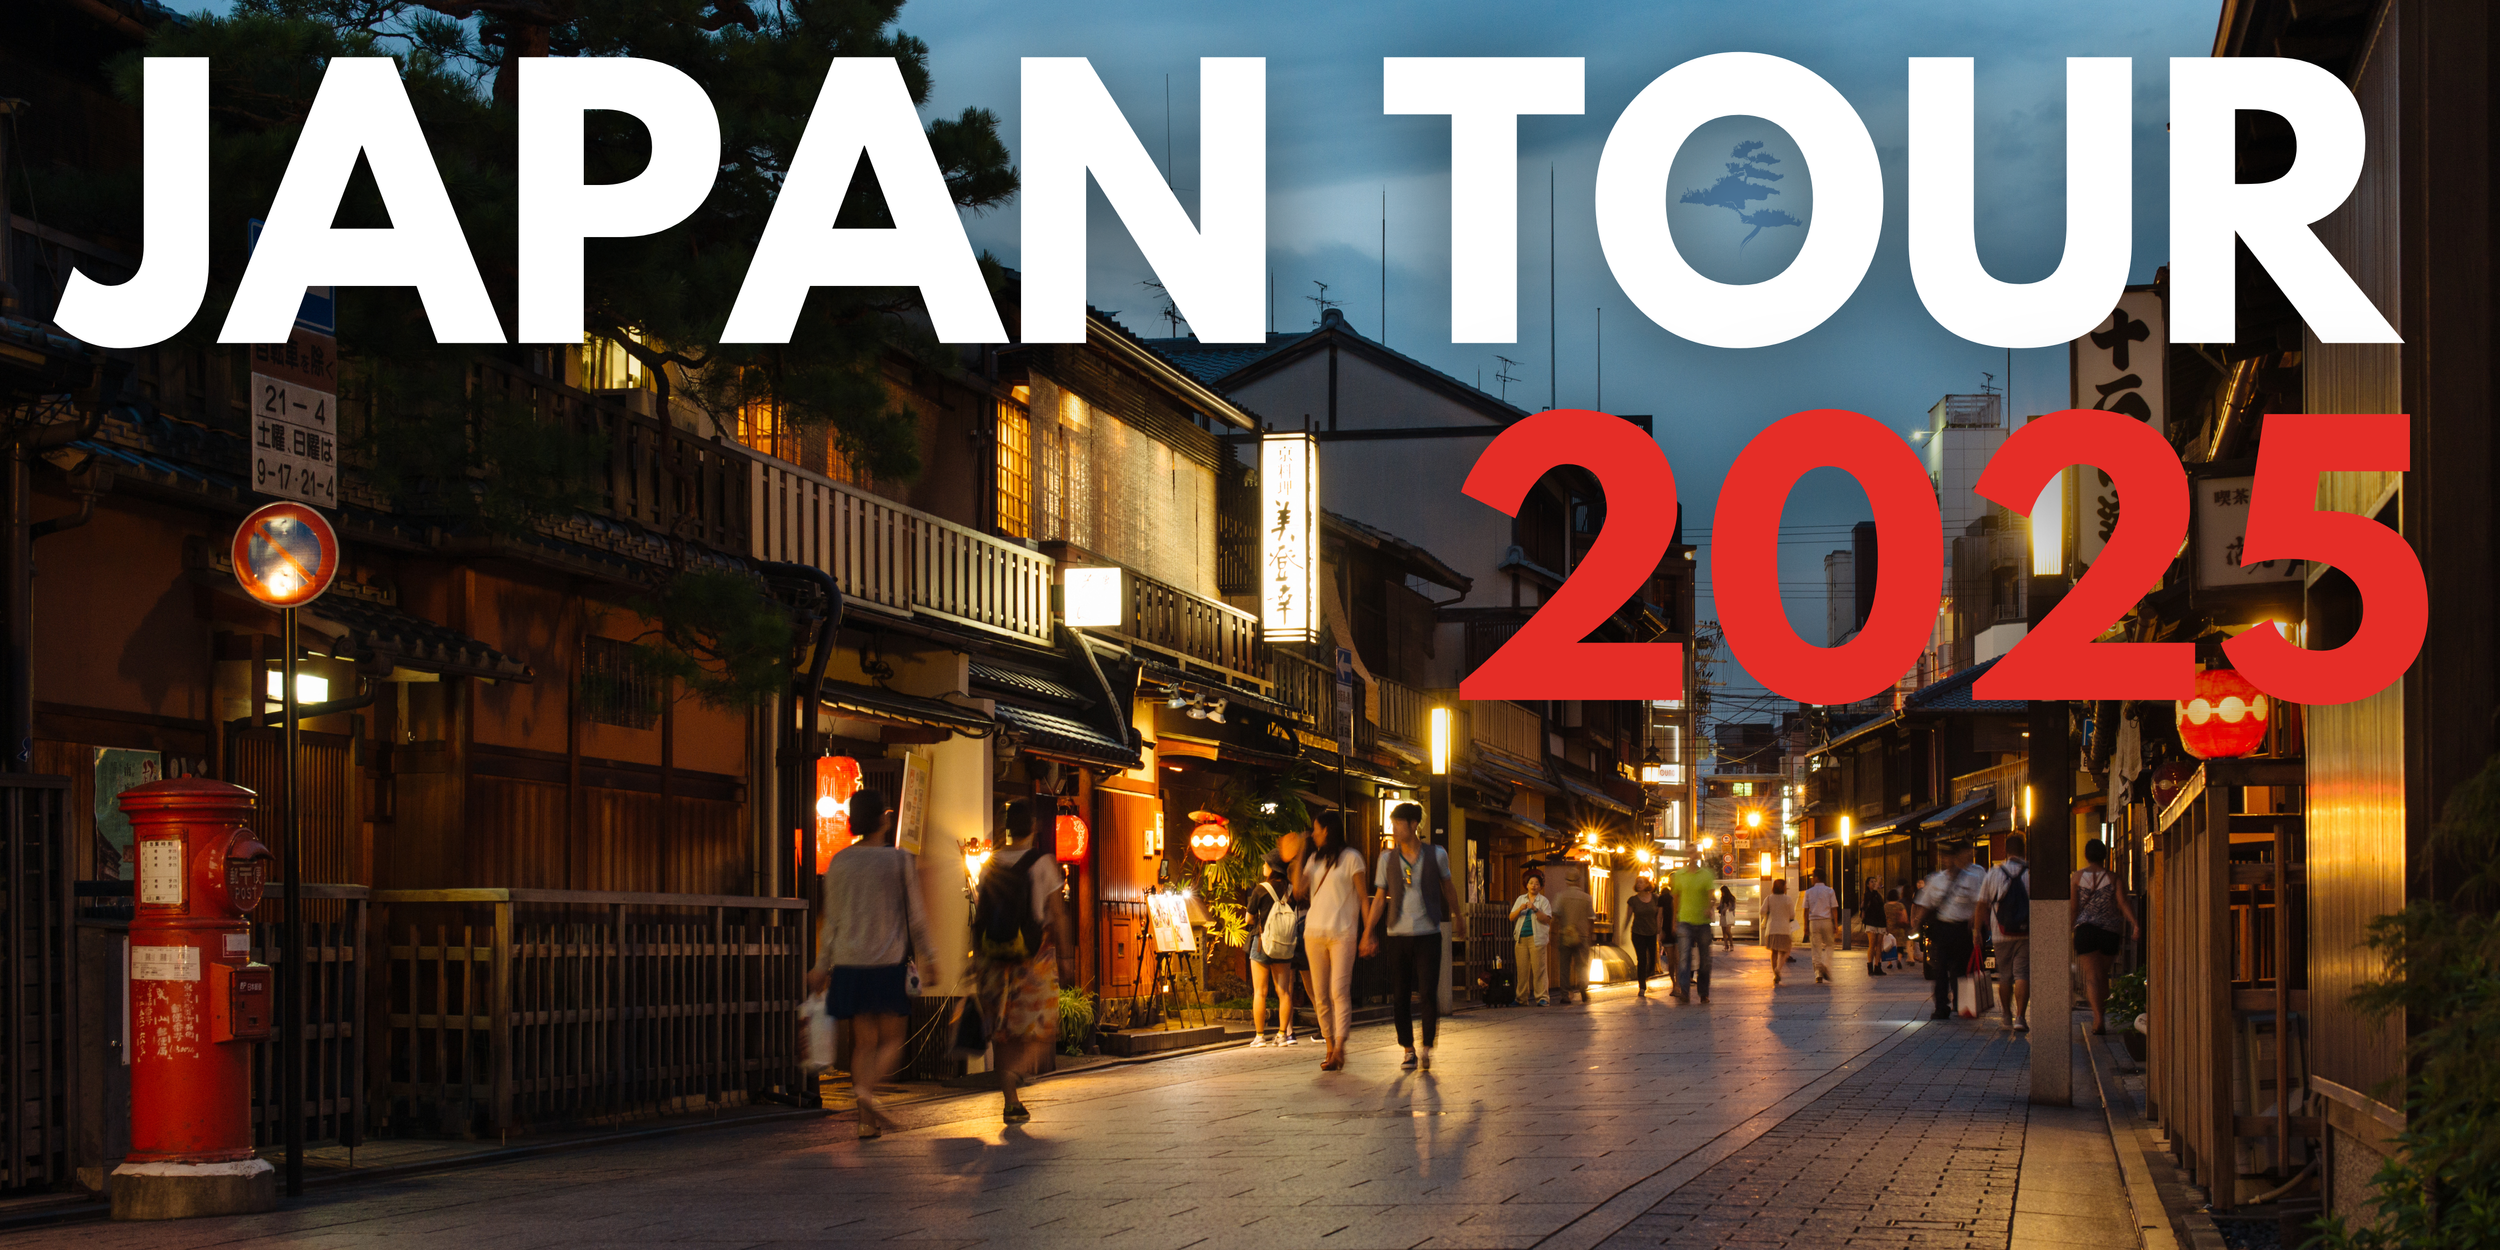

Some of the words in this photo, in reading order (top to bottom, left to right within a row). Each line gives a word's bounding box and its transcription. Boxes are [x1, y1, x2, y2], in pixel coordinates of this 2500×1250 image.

[257, 421, 333, 462] 土曜、日曜は
[2213, 488, 2250, 507] 喫茶
[235, 885, 257, 900] POST
